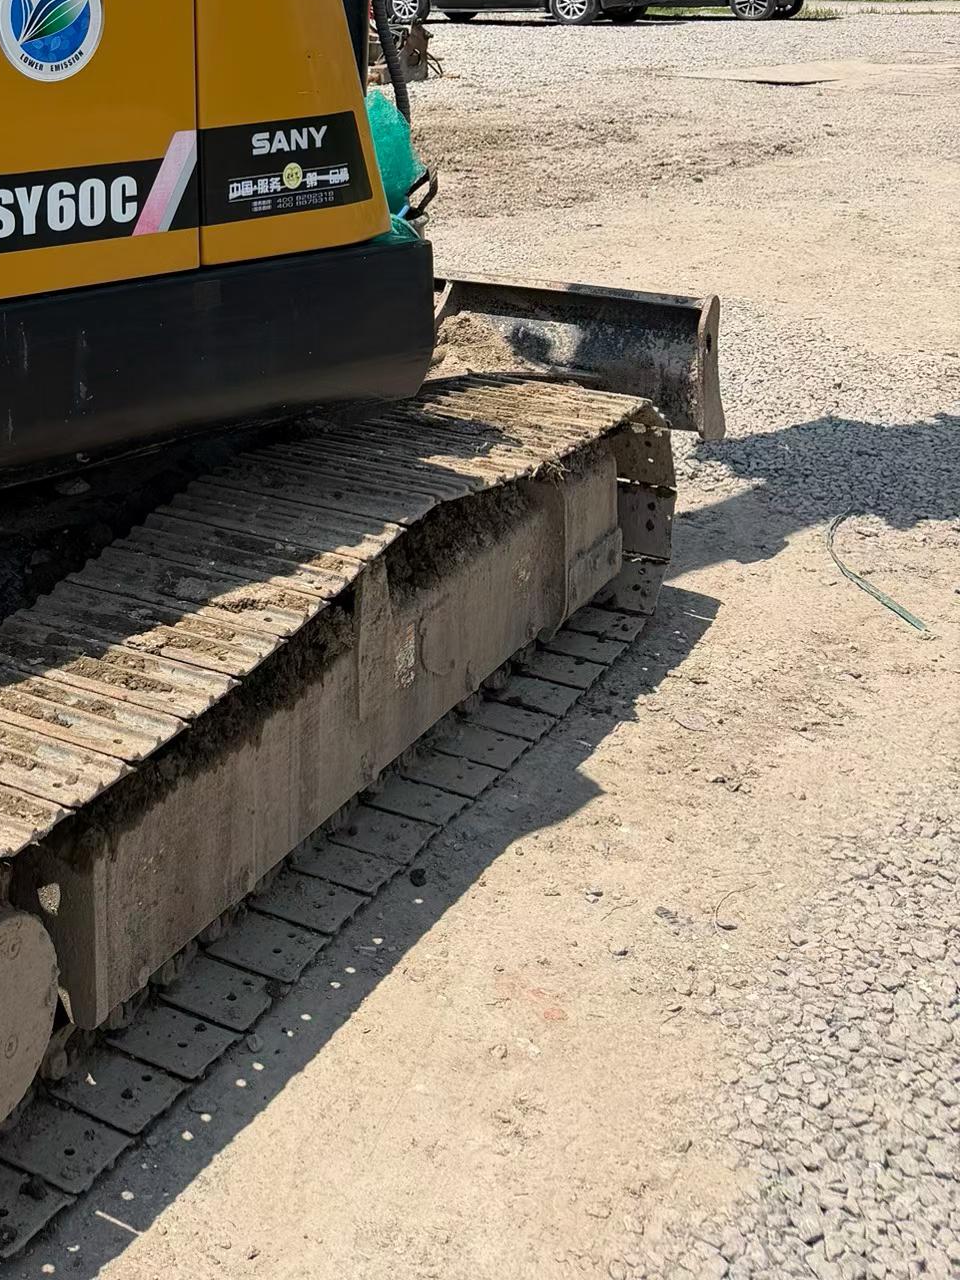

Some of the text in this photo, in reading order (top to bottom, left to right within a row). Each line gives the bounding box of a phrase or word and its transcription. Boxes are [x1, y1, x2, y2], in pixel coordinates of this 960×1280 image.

[19, 49, 84, 72] LOWER EMISSION
[251, 125, 327, 156] SANY
